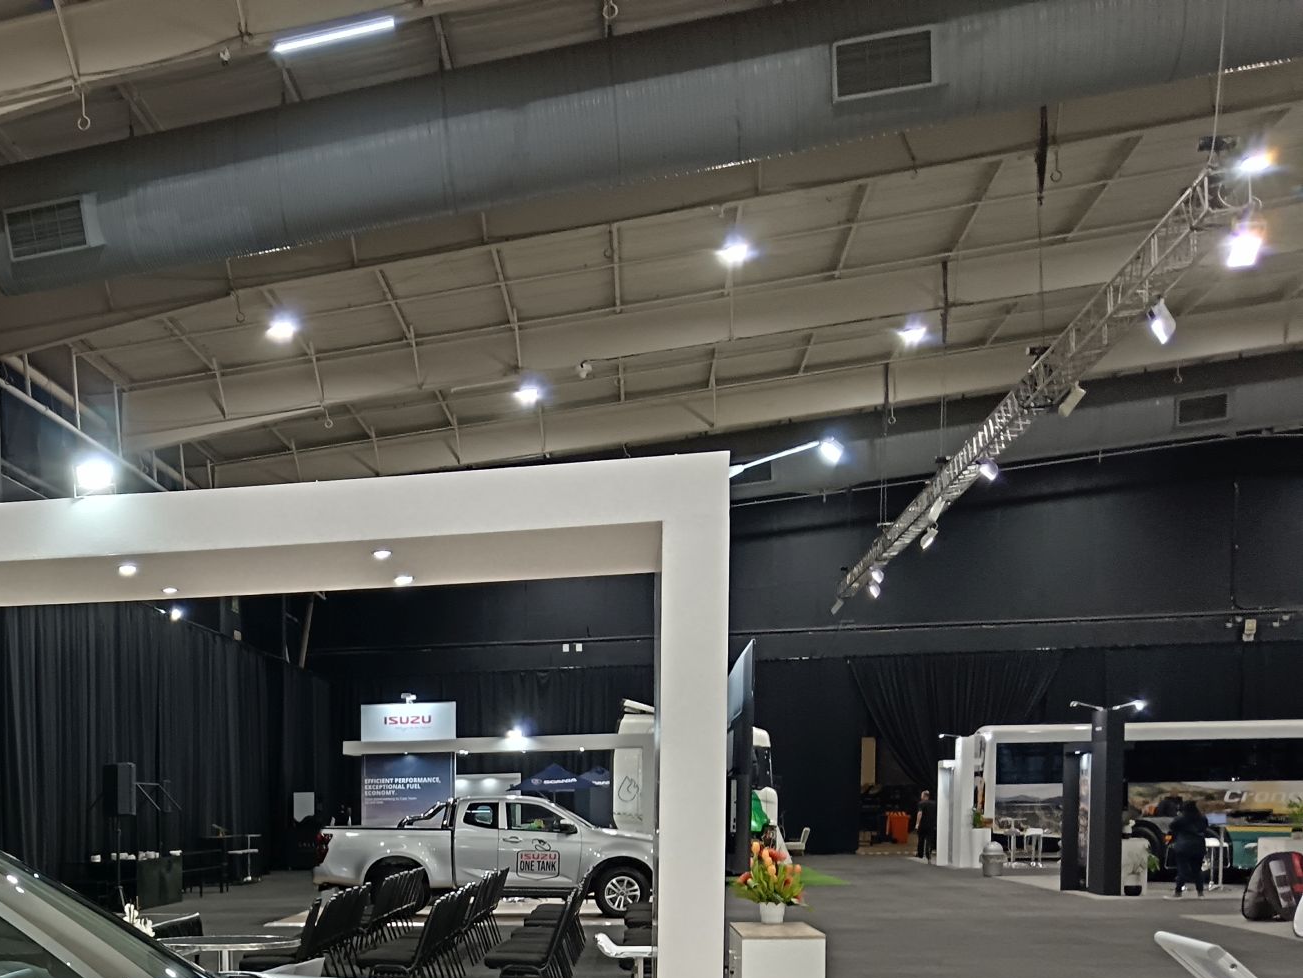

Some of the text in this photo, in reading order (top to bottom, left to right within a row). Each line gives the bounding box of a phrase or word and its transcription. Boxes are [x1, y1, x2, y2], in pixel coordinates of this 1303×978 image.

[384, 715, 431, 725] ISUZU
[519, 860, 556, 872] ONE TANK
